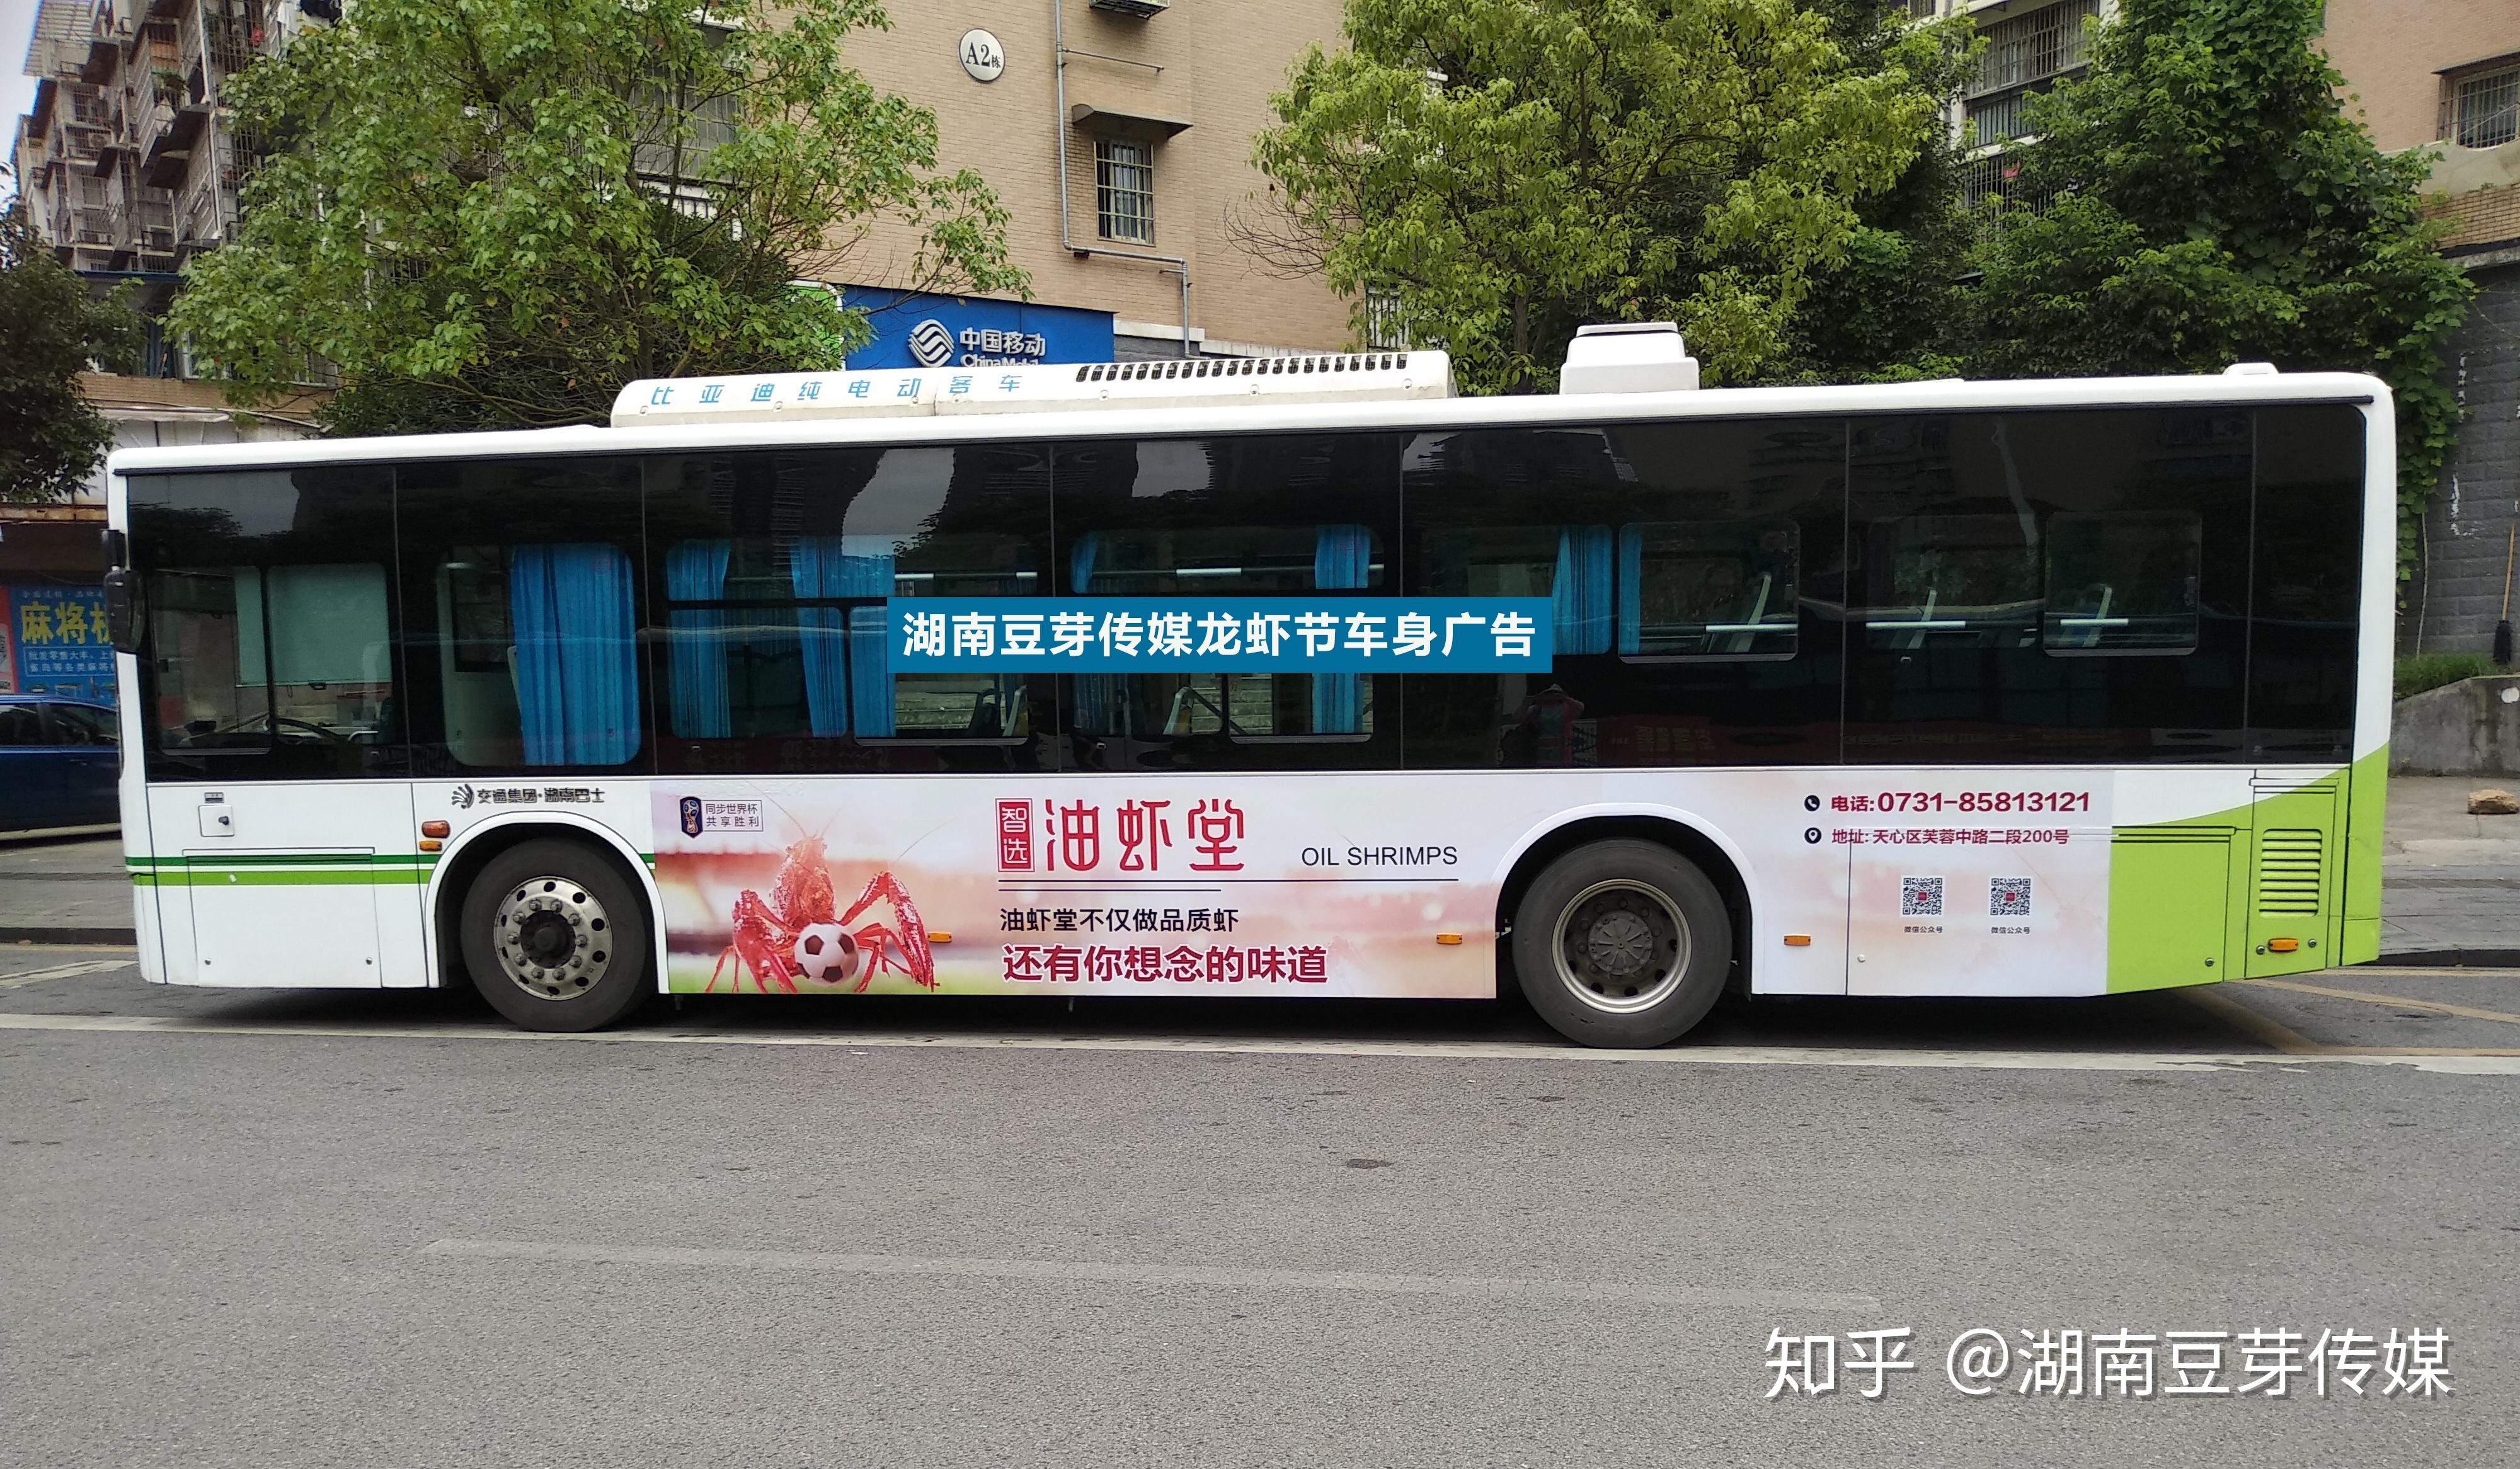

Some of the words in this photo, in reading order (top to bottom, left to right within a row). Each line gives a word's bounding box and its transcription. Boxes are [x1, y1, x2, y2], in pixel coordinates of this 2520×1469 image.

[959, 328, 1047, 358] 中国移动
[651, 375, 1021, 406] 比亚迪纯电动客车
[477, 787, 605, 804] 交通集团·湖南巴士
[705, 803, 758, 815] 同步世界杯
[706, 816, 759, 827] 共享胜利
[1002, 806, 1028, 864] 智选
[1045, 798, 1245, 871] 油虾堂
[1302, 847, 1339, 866] OIL
[1347, 846, 1458, 866] SHRIMPS
[999, 907, 1239, 932] 油虾堂不仅做品质虾
[1004, 945, 1328, 983] 还有你想念的味道
